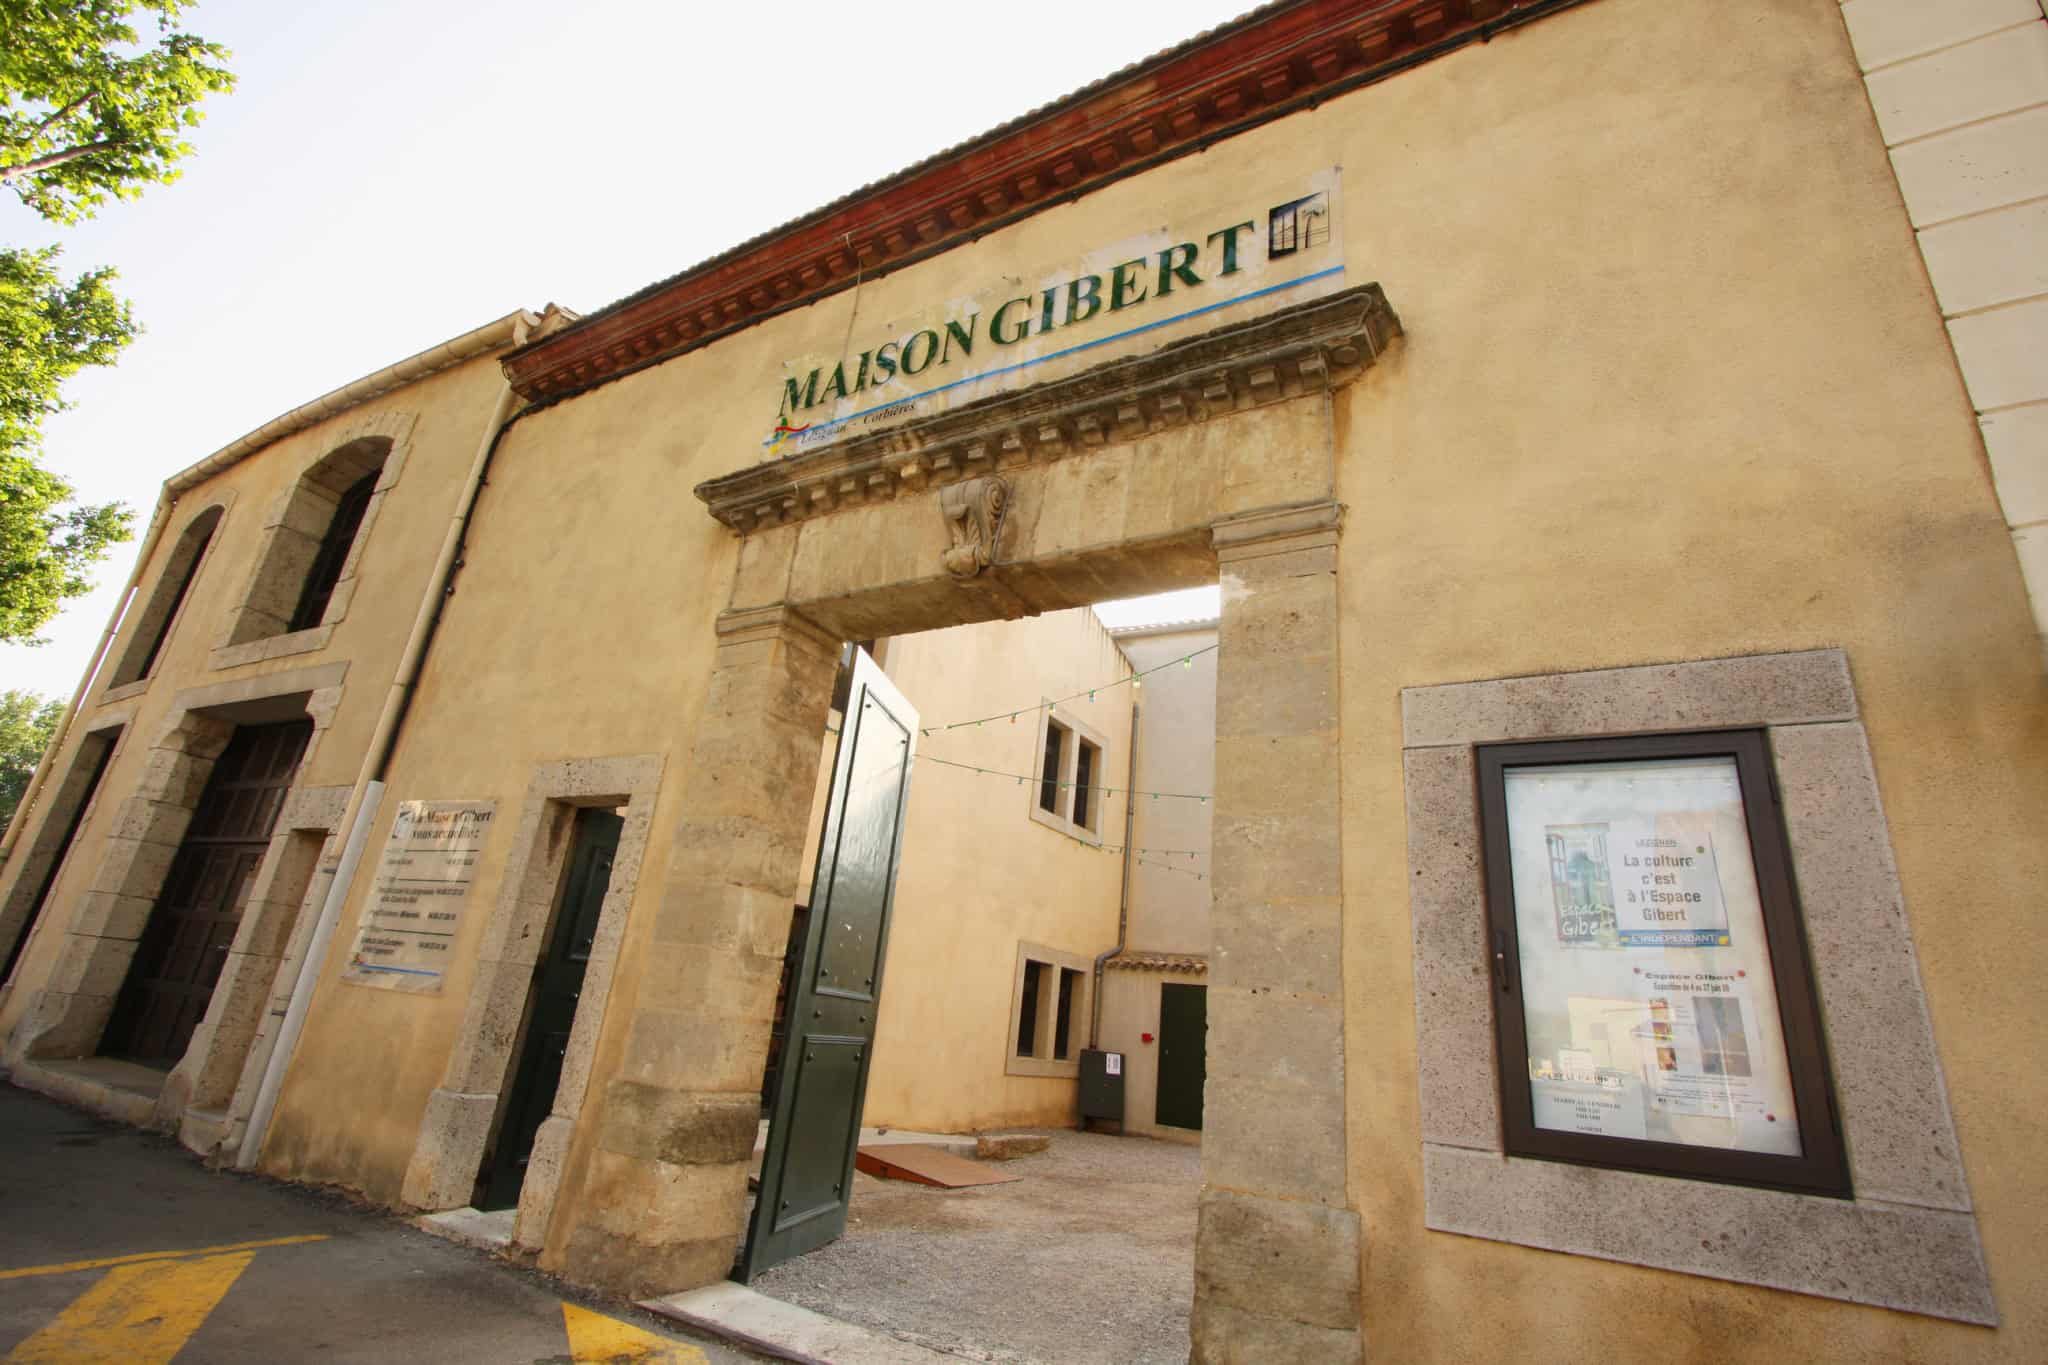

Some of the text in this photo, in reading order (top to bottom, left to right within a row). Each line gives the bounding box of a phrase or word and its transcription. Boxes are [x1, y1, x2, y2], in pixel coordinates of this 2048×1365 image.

[777, 219, 1256, 418] MAISON GIBERT
[863, 402, 916, 426] Corbières
[1623, 855, 1694, 868] La culture
[1641, 872, 1677, 885] c'est
[1626, 889, 1702, 905] à l'Espace
[1642, 907, 1687, 921] Gibert
